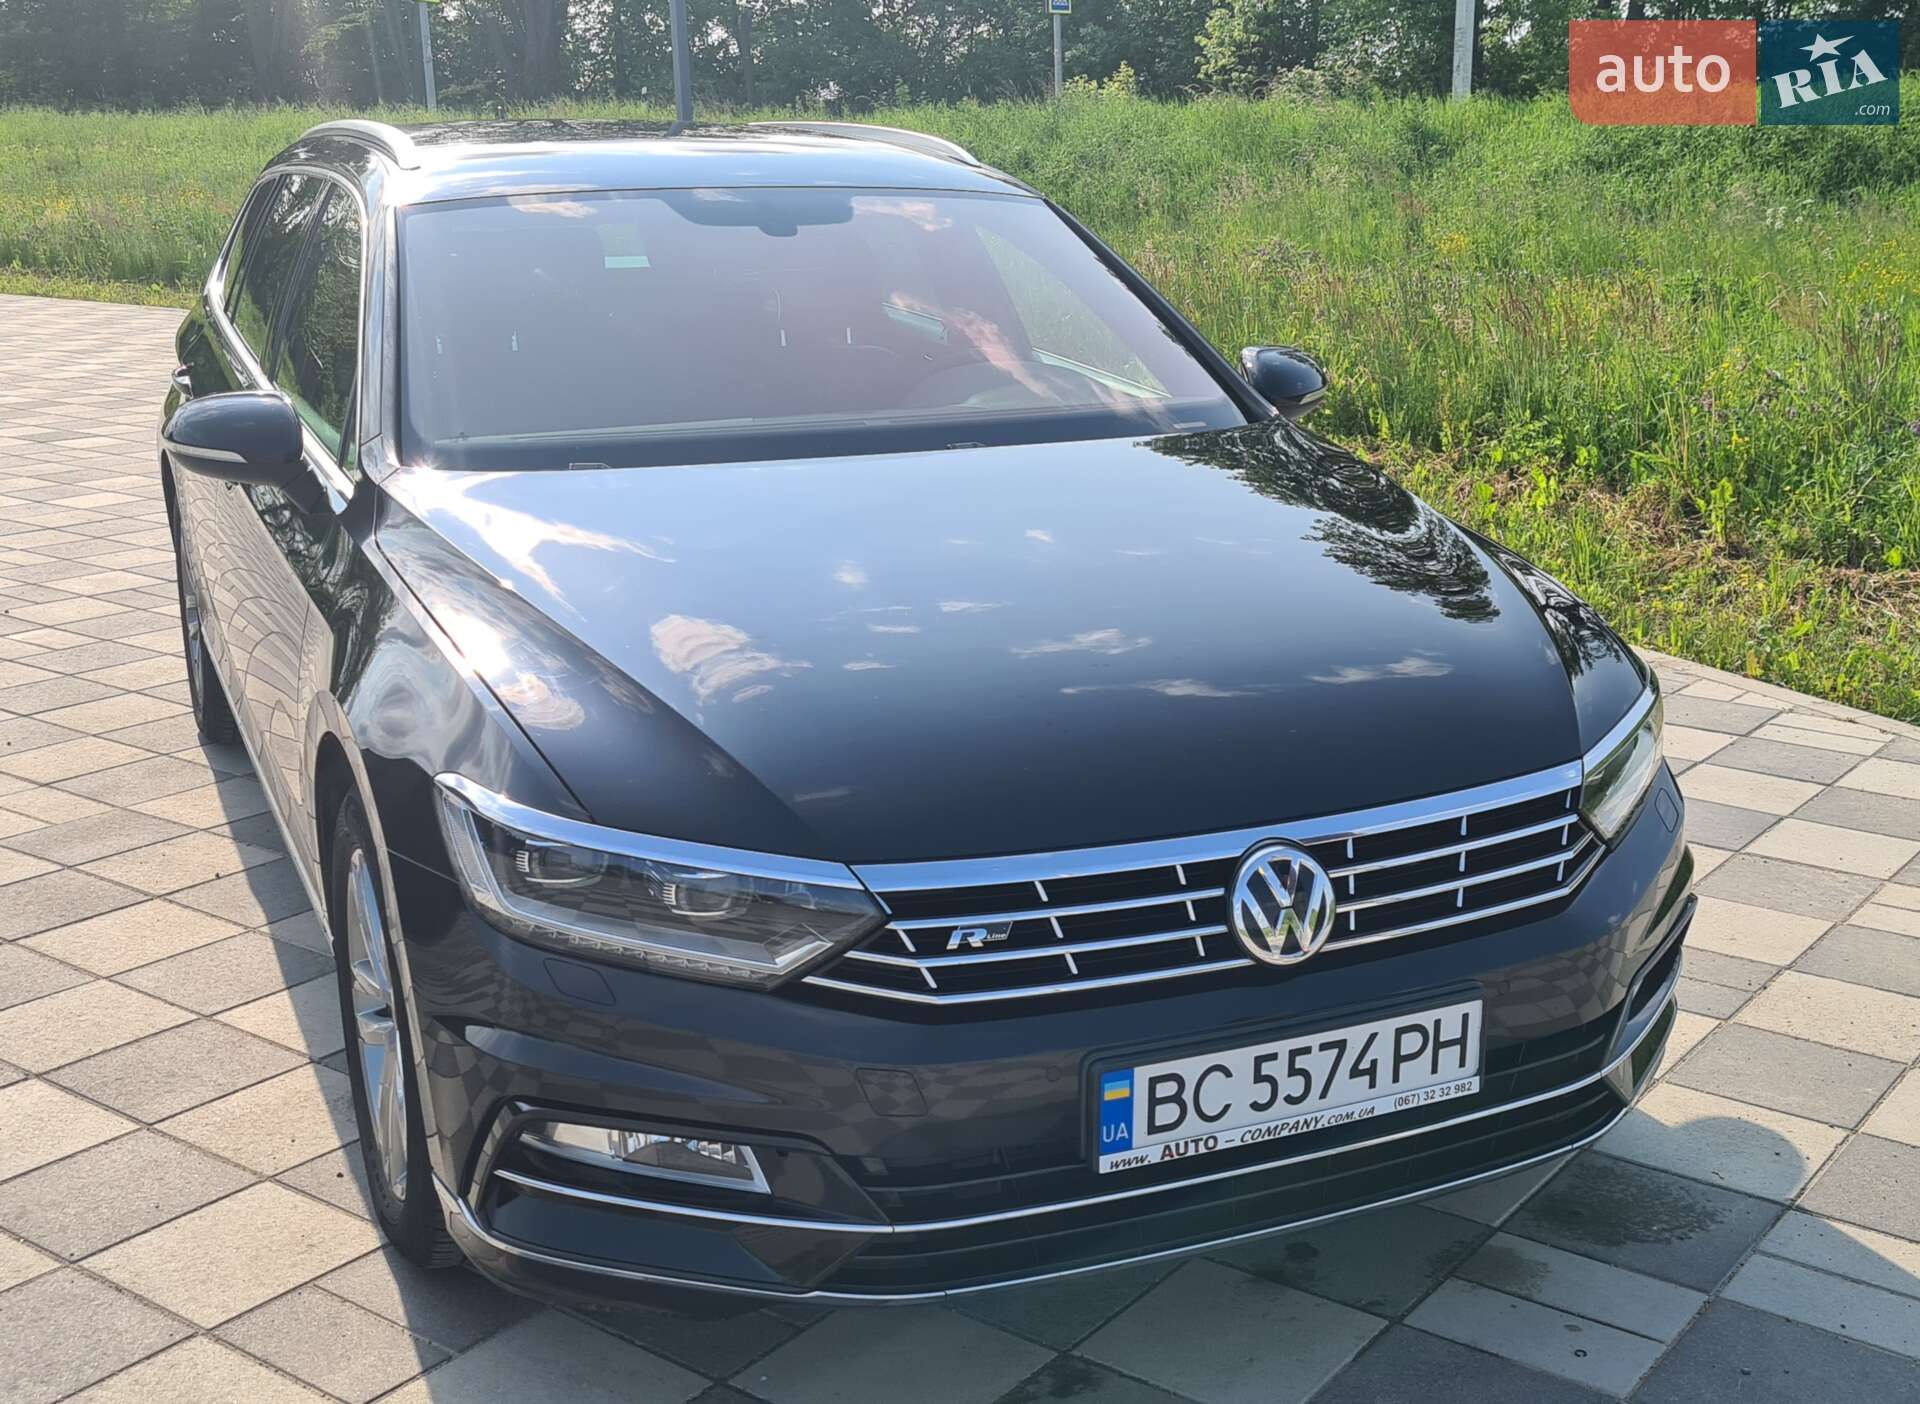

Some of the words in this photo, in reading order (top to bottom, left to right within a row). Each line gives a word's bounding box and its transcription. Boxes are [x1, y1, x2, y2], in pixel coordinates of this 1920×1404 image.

[1146, 1063, 1234, 1136] BC
[1248, 1031, 1379, 1112] 5574
[1391, 1012, 1470, 1084] PH
[1393, 1093, 1421, 1110] (067)
[1423, 1088, 1436, 1102] 32
[1438, 1085, 1452, 1098] 32
[1454, 1080, 1474, 1095] 982
[1103, 1122, 1129, 1143] UA
[1160, 1135, 1219, 1161] AUTO
